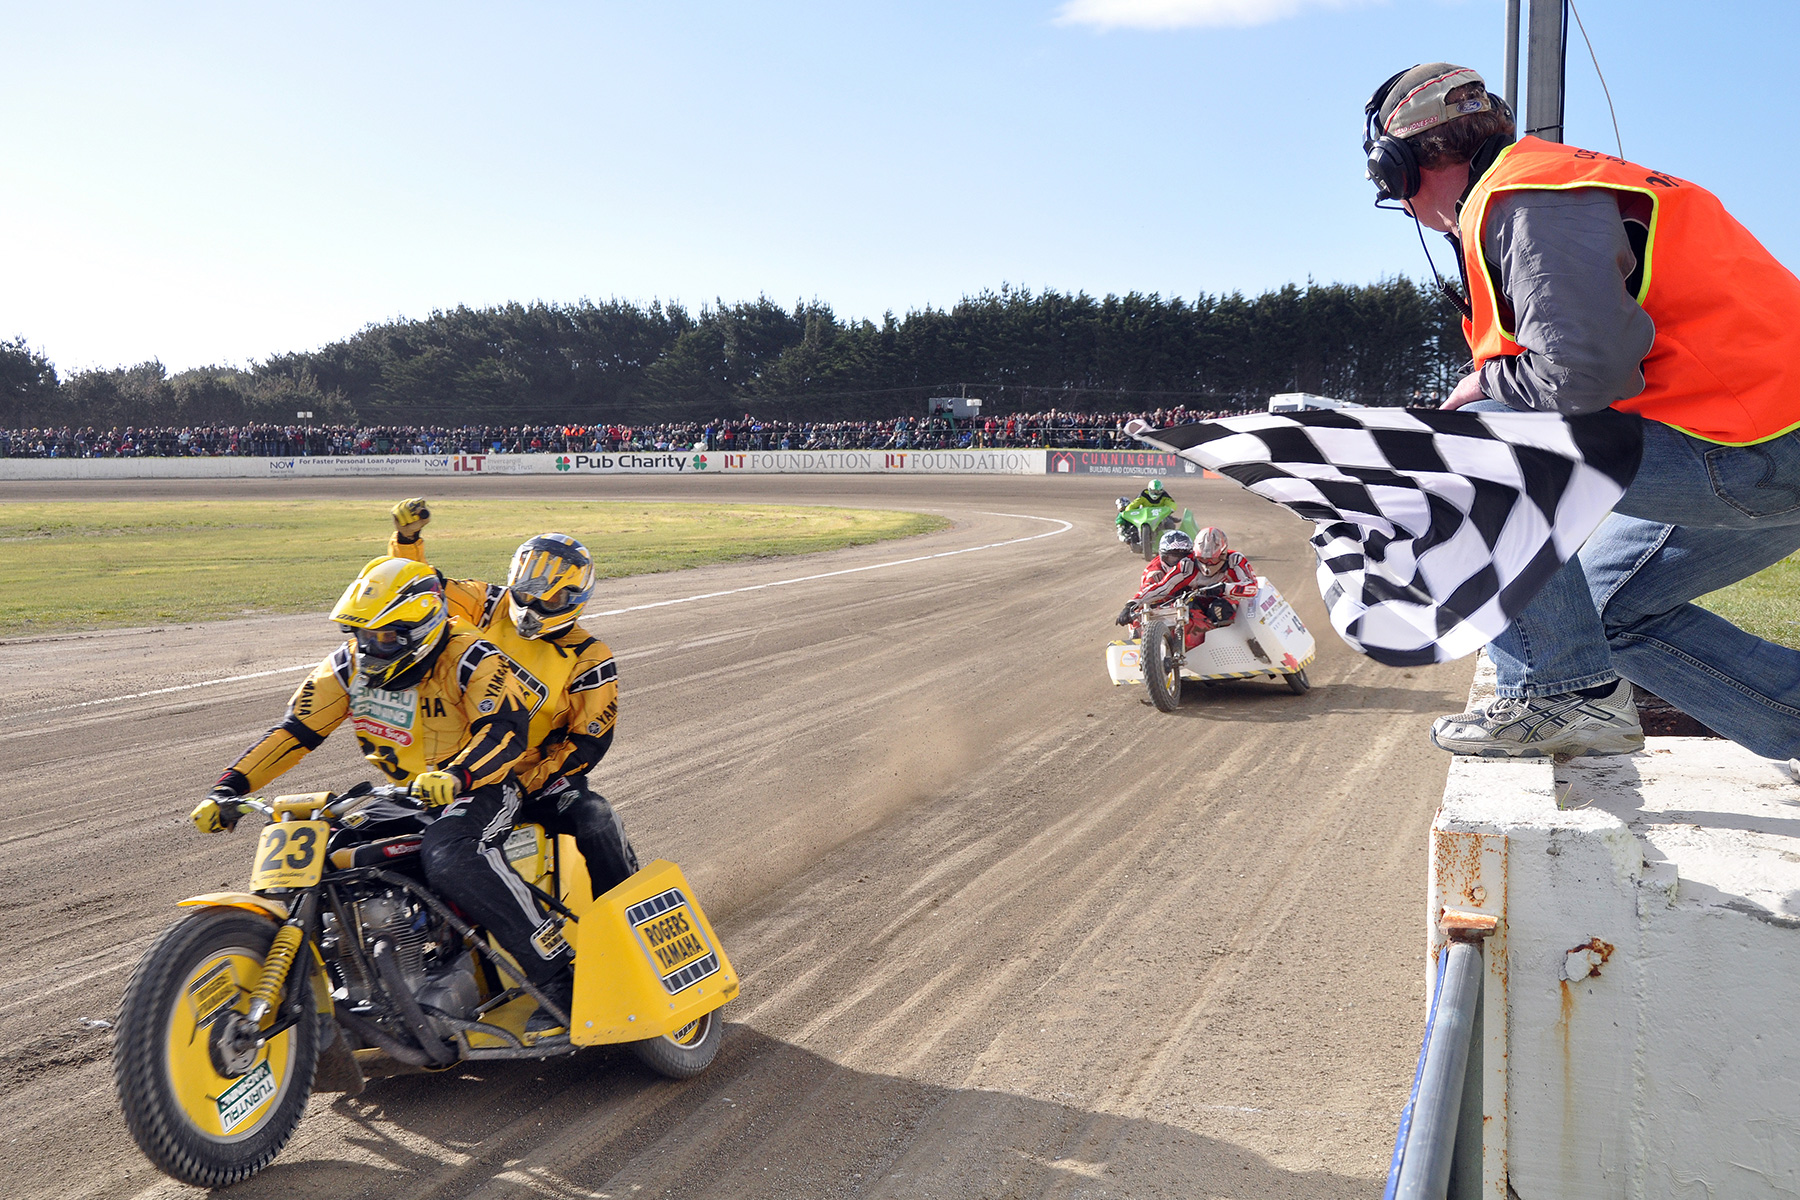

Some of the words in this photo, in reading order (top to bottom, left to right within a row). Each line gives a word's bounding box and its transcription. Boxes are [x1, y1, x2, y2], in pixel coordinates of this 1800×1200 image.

[270, 458, 294, 469] NOW
[336, 457, 366, 465] Personal
[367, 457, 385, 465] Loan
[387, 456, 421, 466] Approvals
[425, 456, 448, 467] NOW
[575, 455, 614, 469] Pub
[618, 454, 687, 471] Charity
[751, 453, 872, 469] FOUNDATION
[911, 453, 1031, 470] FOUNDATION
[1081, 452, 1177, 467] CUNNINGHAM
[1089, 465, 1111, 474] BUILDING
[1112, 466, 1123, 474] AND
[1123, 466, 1158, 475] CONSTRUCTION
[1158, 467, 1168, 476] LTD
[259, 826, 316, 872] 23
[644, 911, 690, 948] ROGERS
[654, 933, 704, 970] YAMAHA
[223, 1080, 274, 1128] TURNTRU
